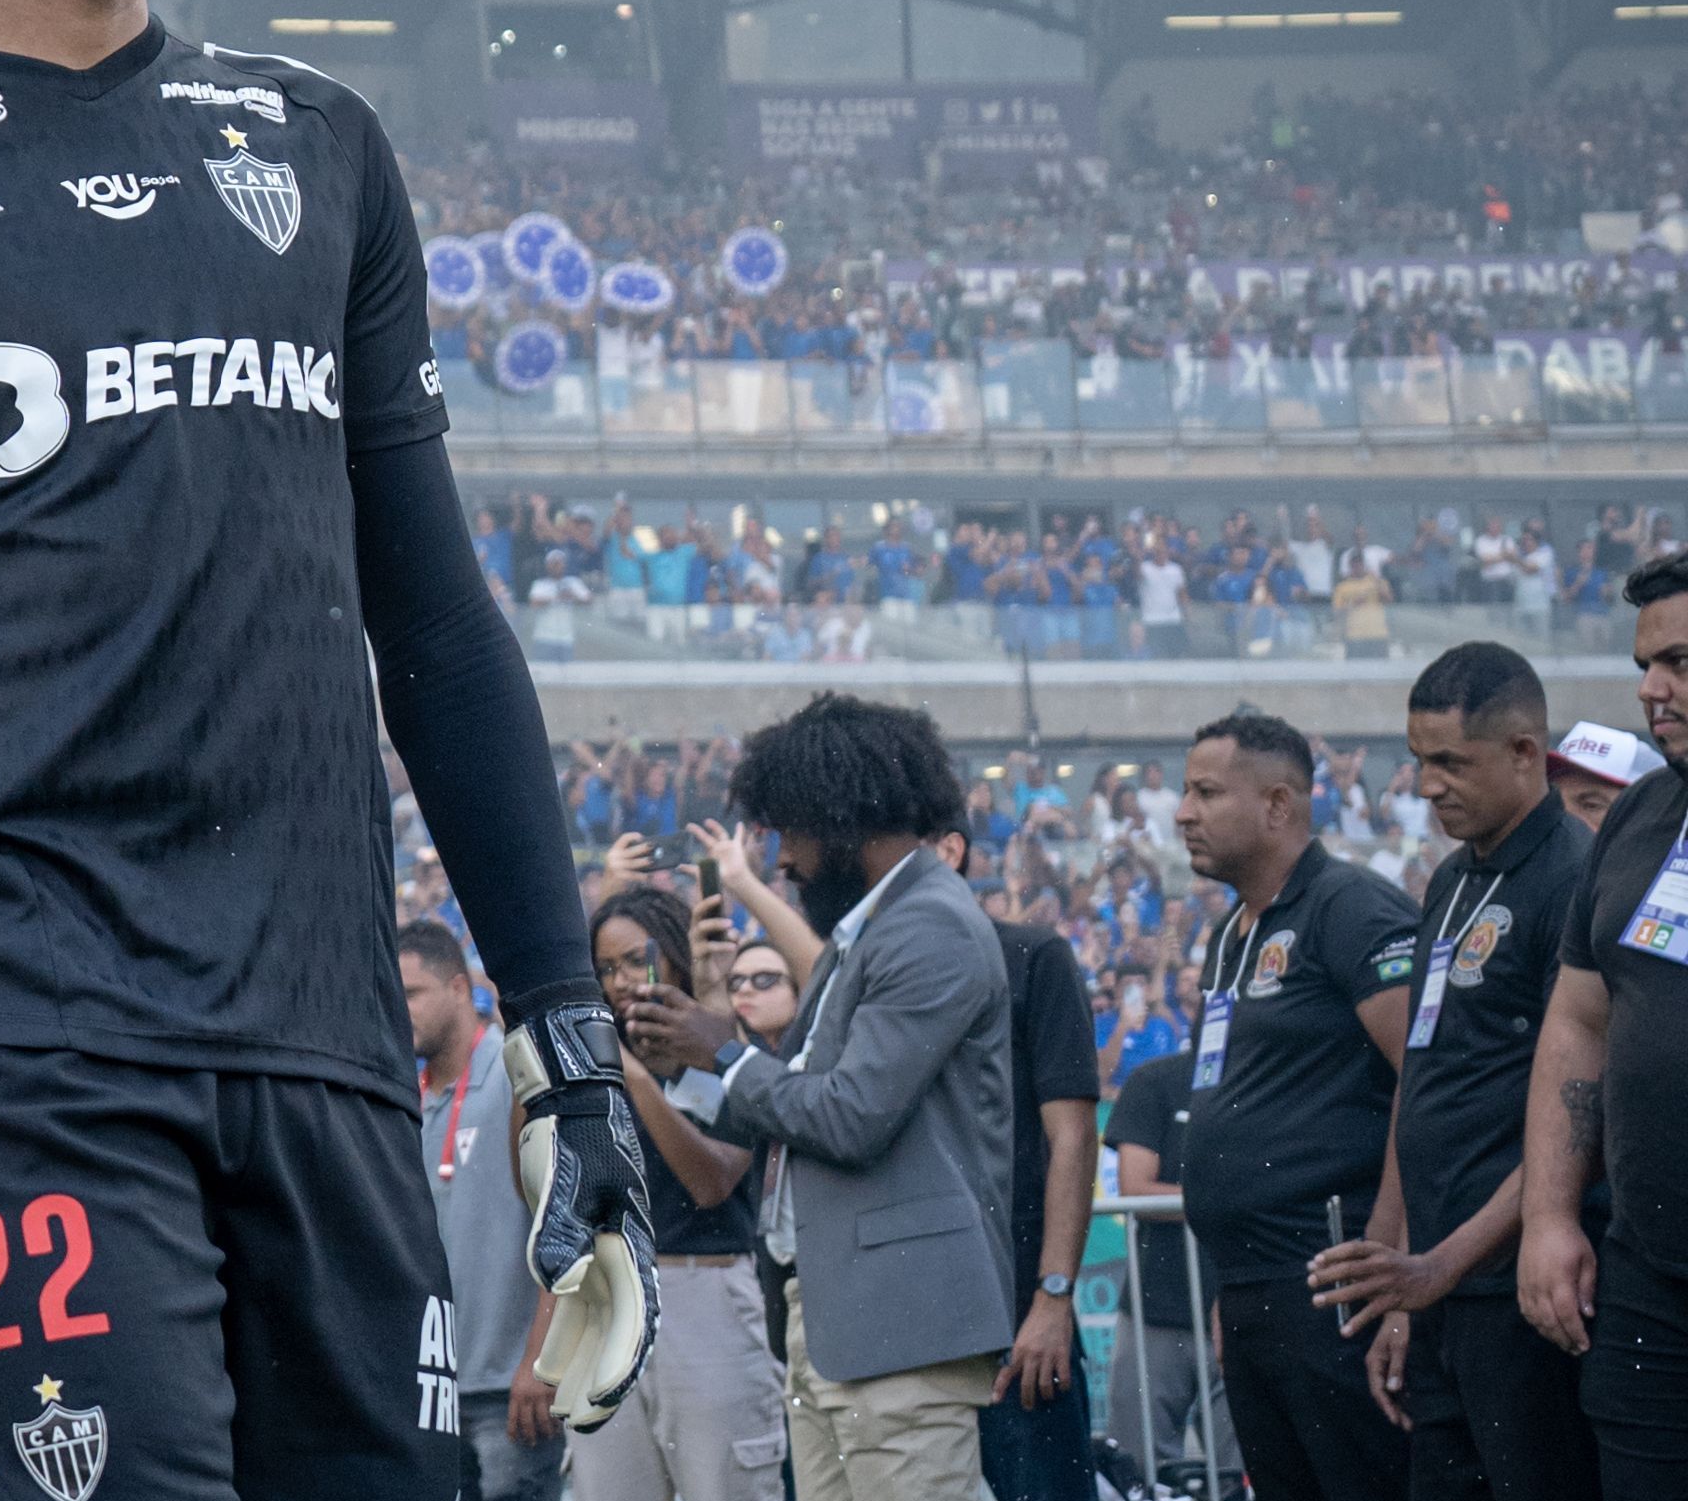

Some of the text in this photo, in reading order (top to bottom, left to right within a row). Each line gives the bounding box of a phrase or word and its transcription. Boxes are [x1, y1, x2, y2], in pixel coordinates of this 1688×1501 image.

[61, 173, 140, 208] YOU
[223, 169, 284, 187] CAM
[28, 1417, 96, 1450] CAM
